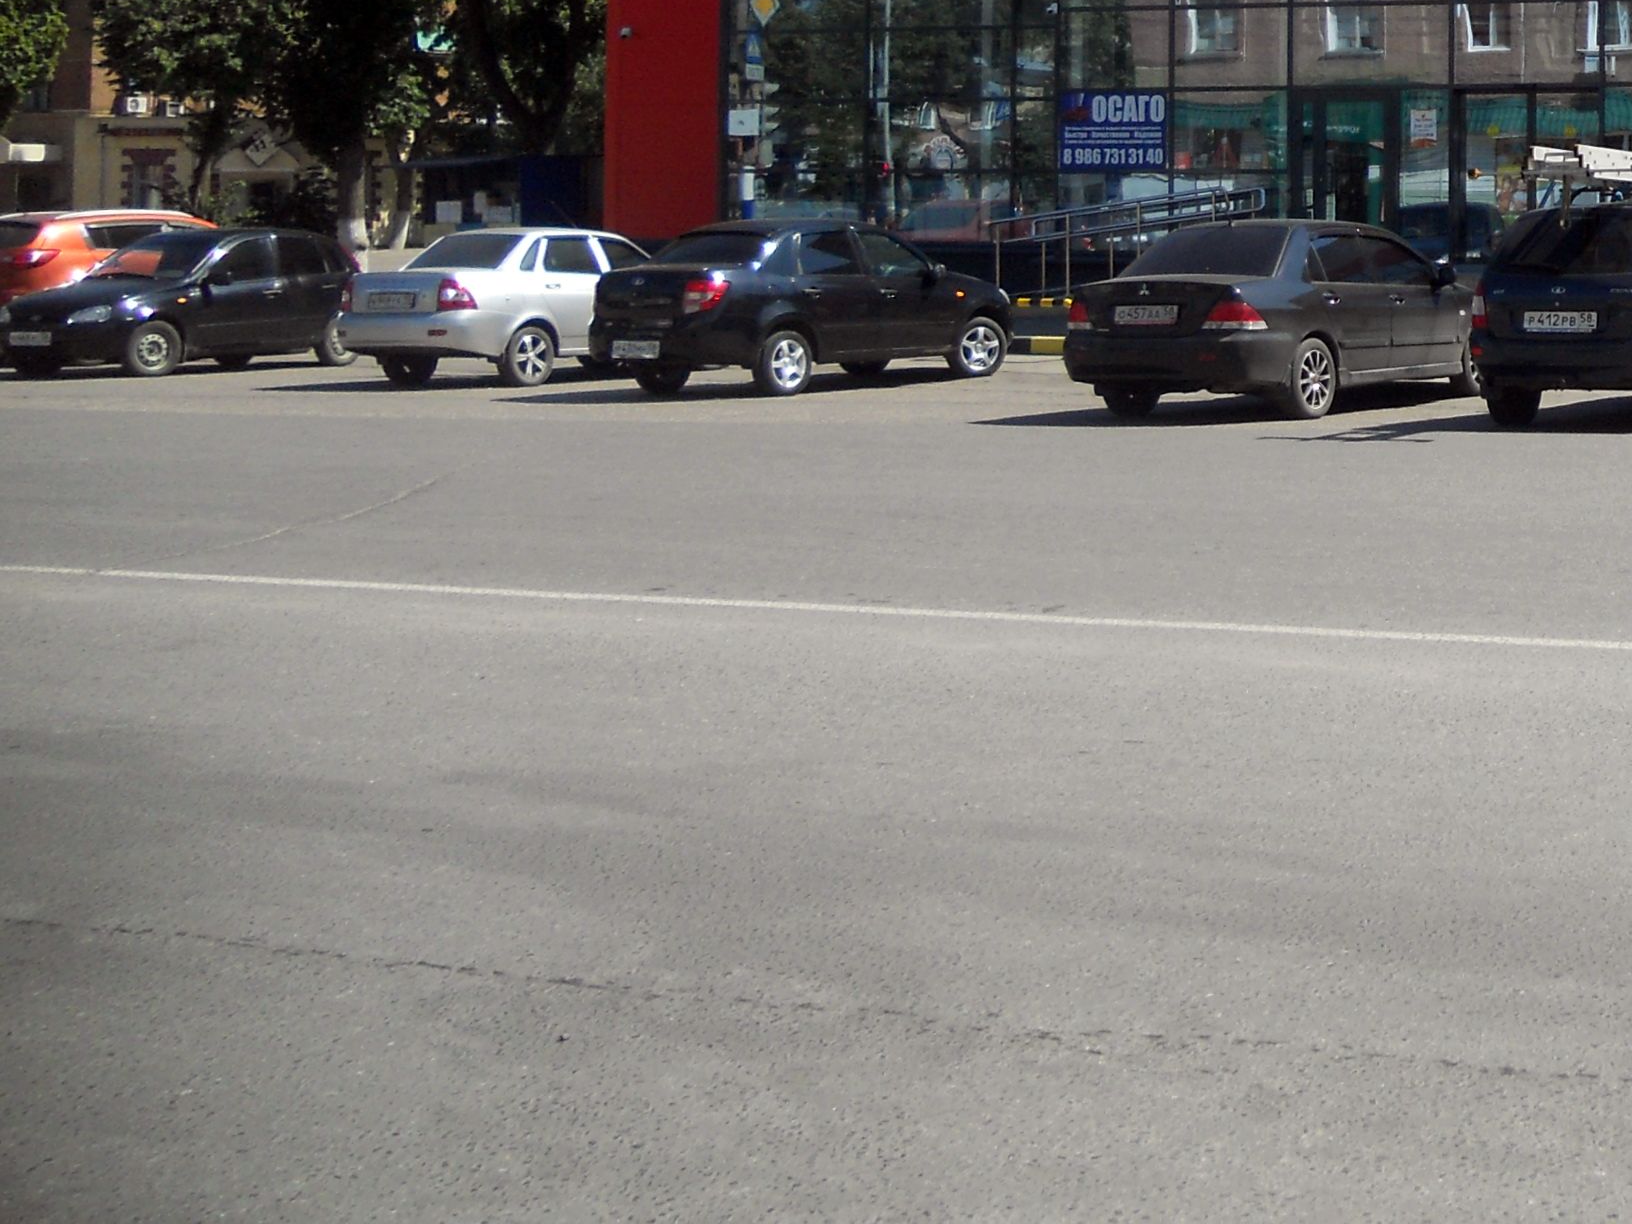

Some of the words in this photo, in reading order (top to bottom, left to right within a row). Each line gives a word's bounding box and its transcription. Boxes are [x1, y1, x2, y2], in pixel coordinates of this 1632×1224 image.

[1092, 94, 1166, 123] ОСАГО
[1064, 148, 1072, 164] 8
[1075, 148, 1101, 164] 986
[1103, 148, 1126, 164] 731
[1128, 148, 1144, 164] 31
[1146, 148, 1163, 164] 40
